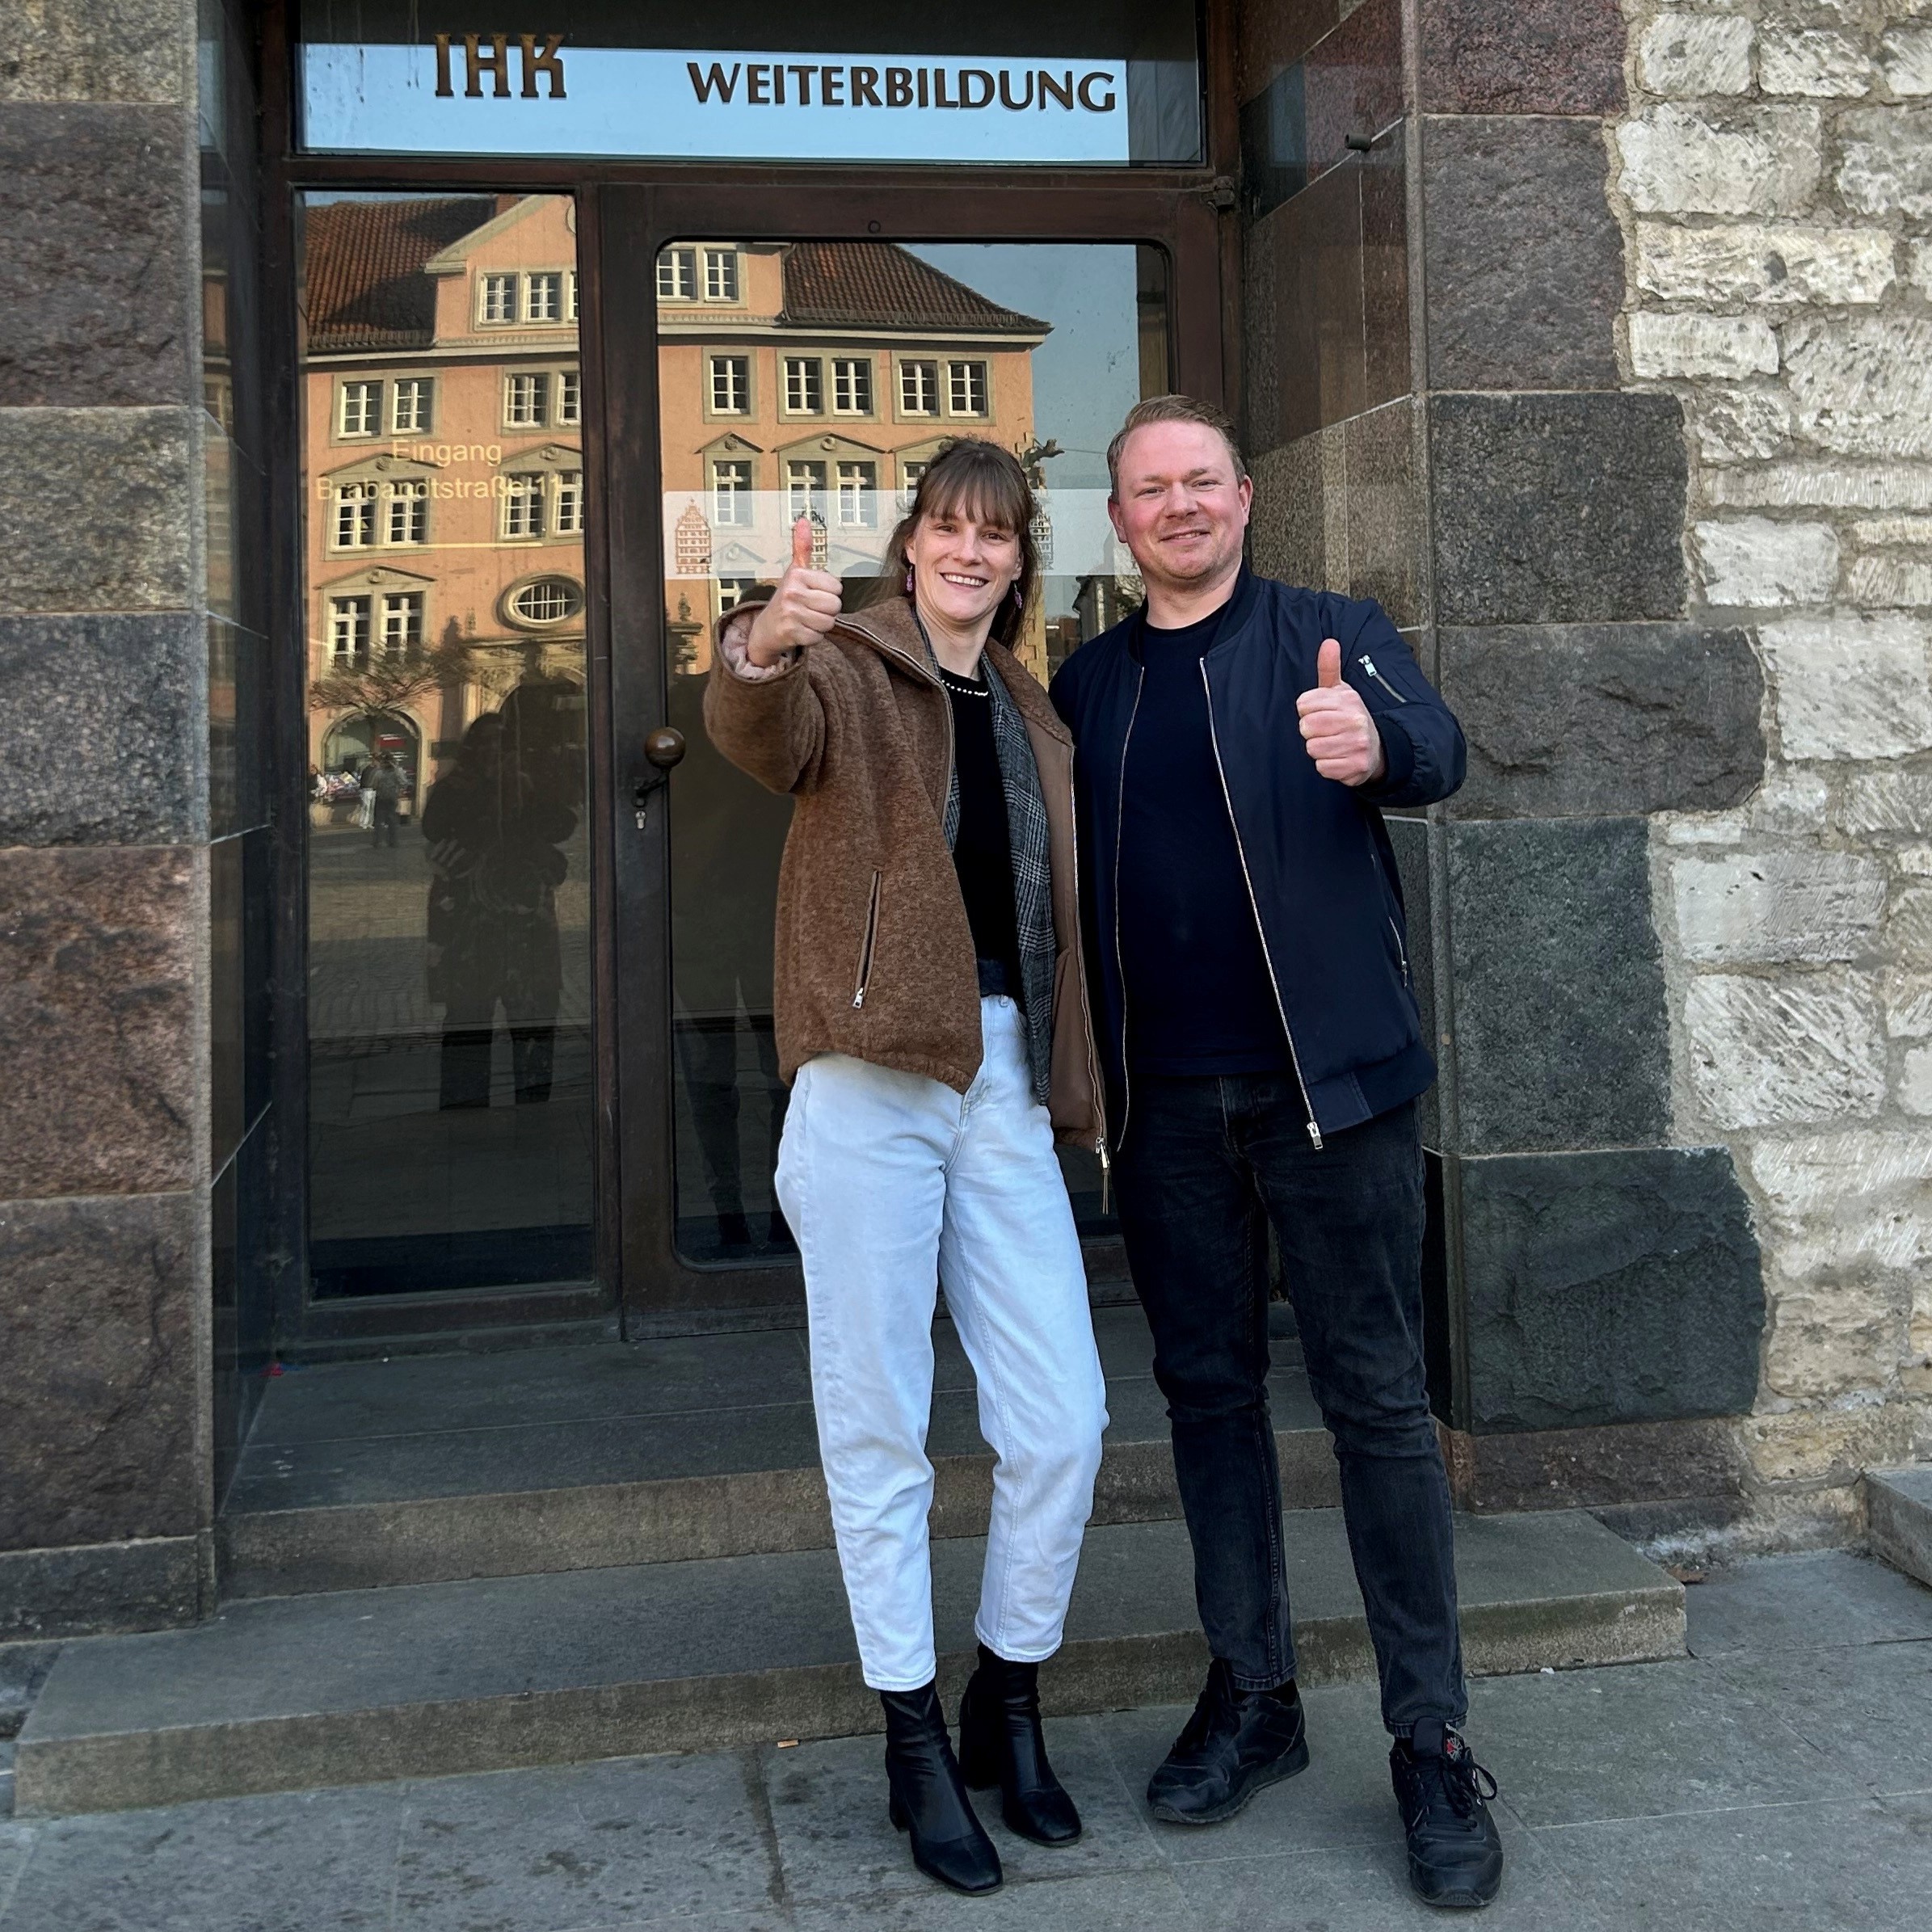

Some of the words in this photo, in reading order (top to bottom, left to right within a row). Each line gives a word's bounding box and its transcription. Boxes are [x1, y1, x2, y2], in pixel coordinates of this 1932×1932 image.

[435, 32, 567, 98] IHK
[687, 61, 1117, 112] WEITERBILDUNG
[393, 439, 503, 467] Eingang
[316, 475, 524, 500] Brabandtstraße
